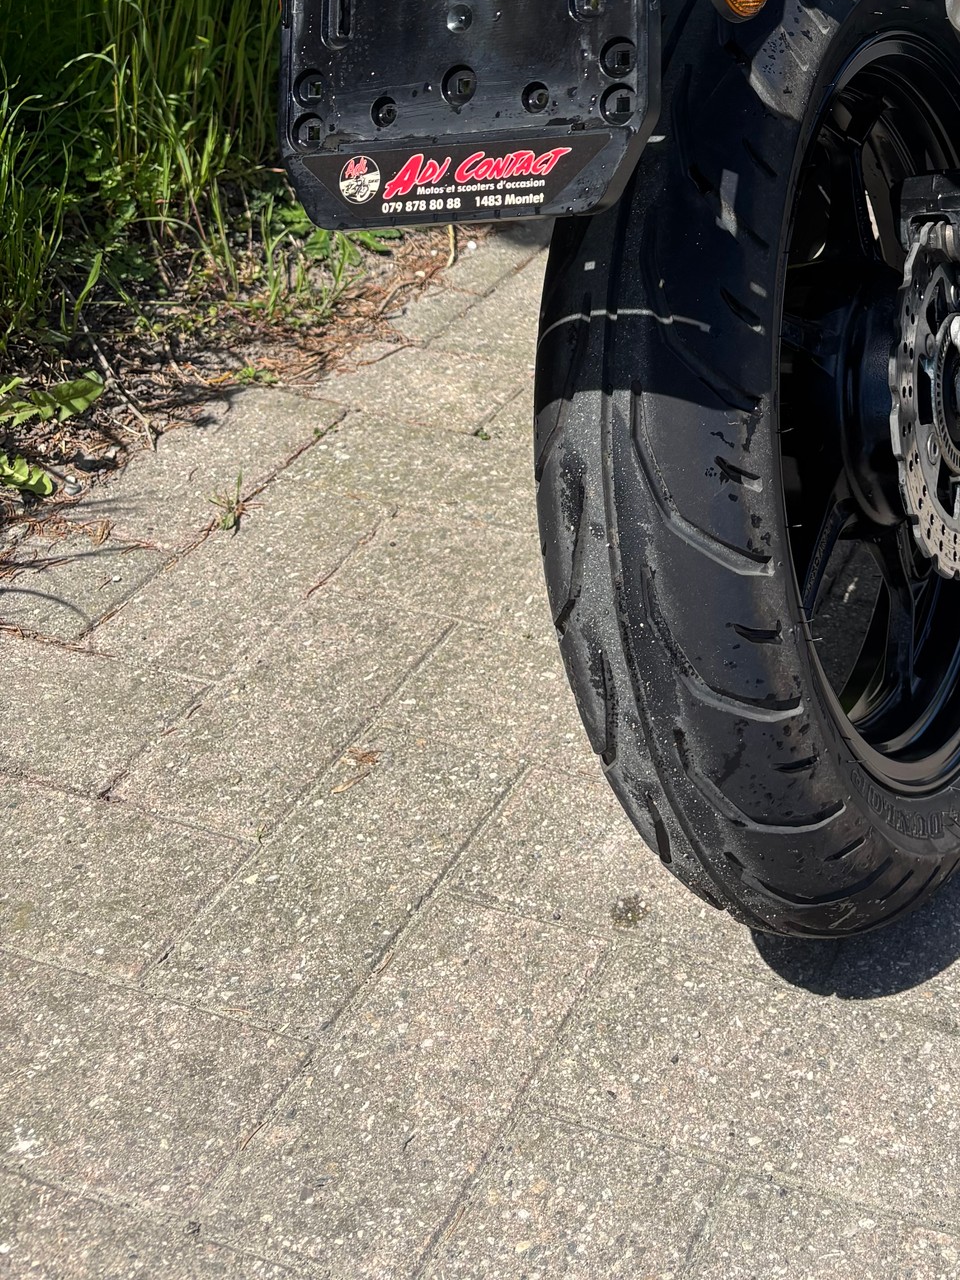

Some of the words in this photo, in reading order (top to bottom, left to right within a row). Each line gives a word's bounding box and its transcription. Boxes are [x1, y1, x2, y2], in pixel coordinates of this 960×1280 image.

[455, 147, 572, 183] CONTACT
[416, 185, 444, 195] Motos
[446, 184, 456, 193] et
[457, 182, 495, 193] scooters
[381, 201, 403, 214] 079
[405, 199, 427, 212] 878
[429, 198, 444, 210] 80
[446, 197, 461, 209] 88
[475, 195, 502, 207] 1483
[504, 193, 545, 206] Montet
